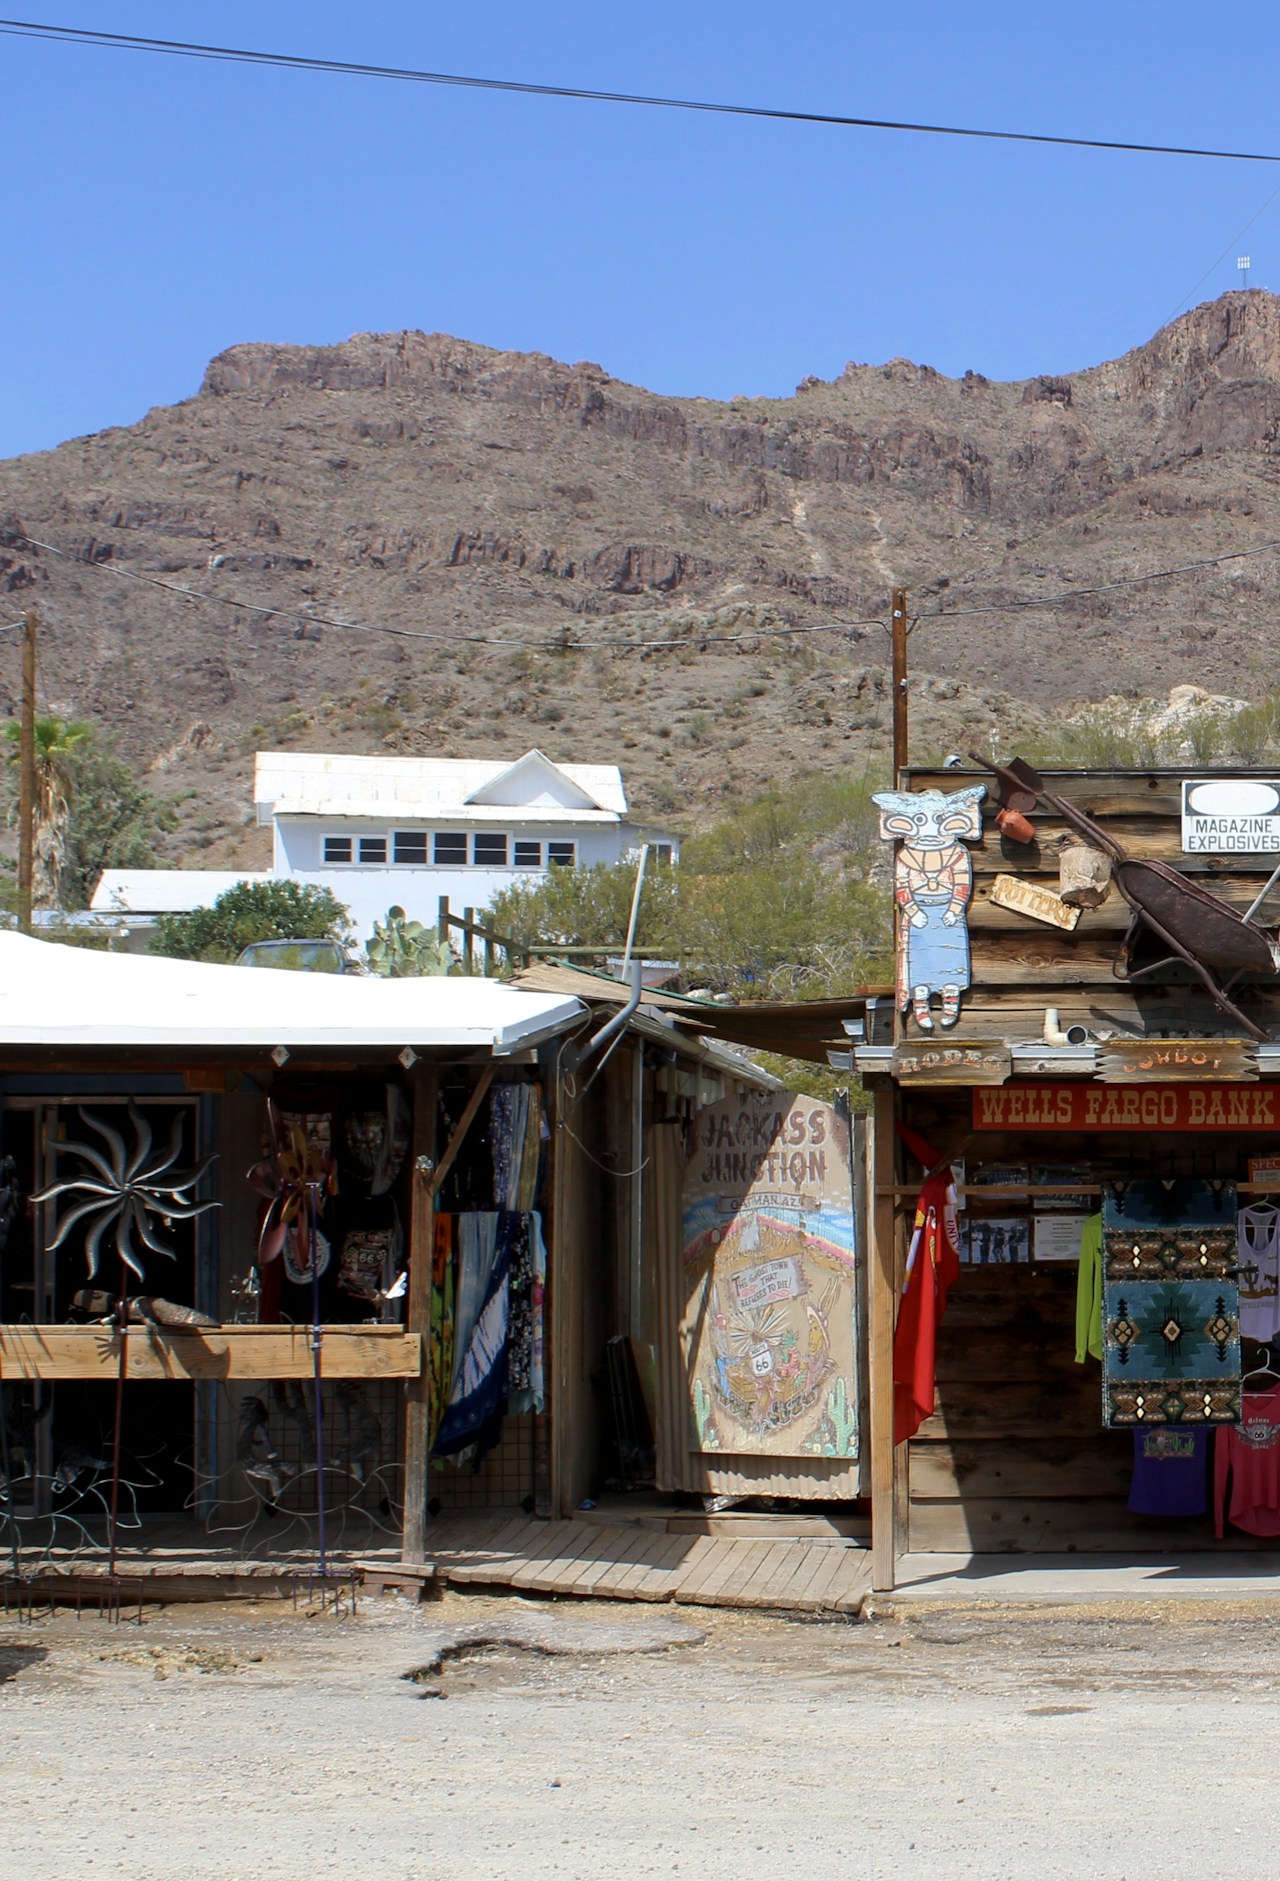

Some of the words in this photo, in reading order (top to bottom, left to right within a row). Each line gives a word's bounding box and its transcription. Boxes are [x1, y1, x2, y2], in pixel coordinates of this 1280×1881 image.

[1195, 819, 1273, 833] MAGAZINE
[1188, 835, 1280, 850] EXPLOSIVES
[995, 878, 1076, 926] POTTERY
[979, 1090, 1073, 1124] WELLS
[1085, 1090, 1178, 1125] FARGO
[1188, 1090, 1276, 1125] BANK
[702, 1109, 827, 1149] JACKASS
[702, 1151, 828, 1183] JUNCTION
[732, 1275, 749, 1298] THE
[748, 1266, 769, 1283] GHOST
[771, 1261, 790, 1272] TOWN
[760, 1272, 778, 1286] THAT
[740, 1286, 767, 1307] REFUSES
[768, 1282, 776, 1293] TO
[755, 1358, 769, 1372] 66
[1254, 1430, 1265, 1439] 66
